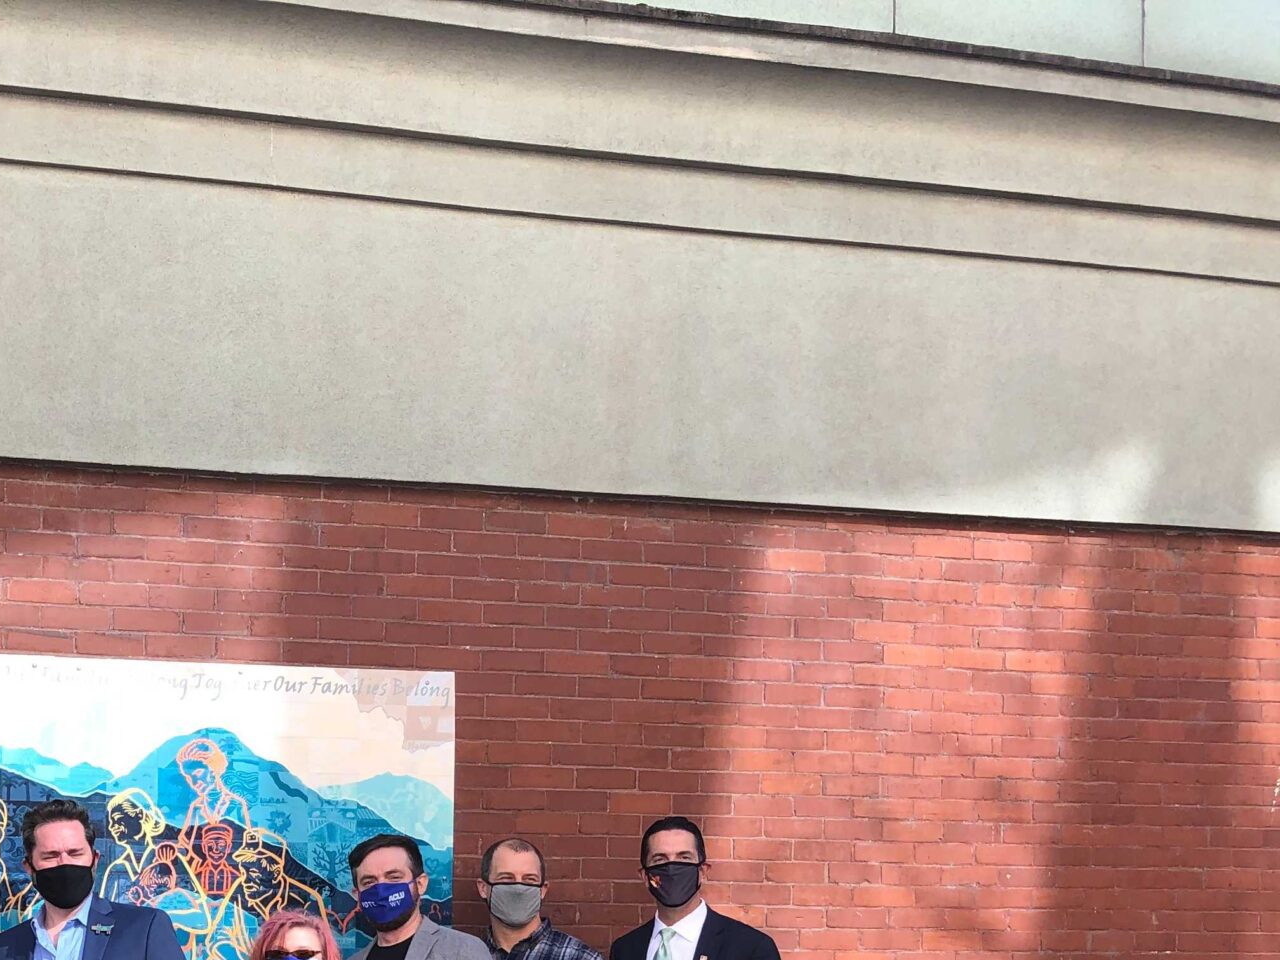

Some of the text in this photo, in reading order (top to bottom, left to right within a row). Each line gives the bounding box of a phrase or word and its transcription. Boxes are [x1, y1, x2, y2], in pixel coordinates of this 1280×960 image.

[273, 676, 308, 694] Our
[309, 676, 389, 697] Families
[393, 678, 451, 709] Belong
[388, 891, 405, 902] ACLU
